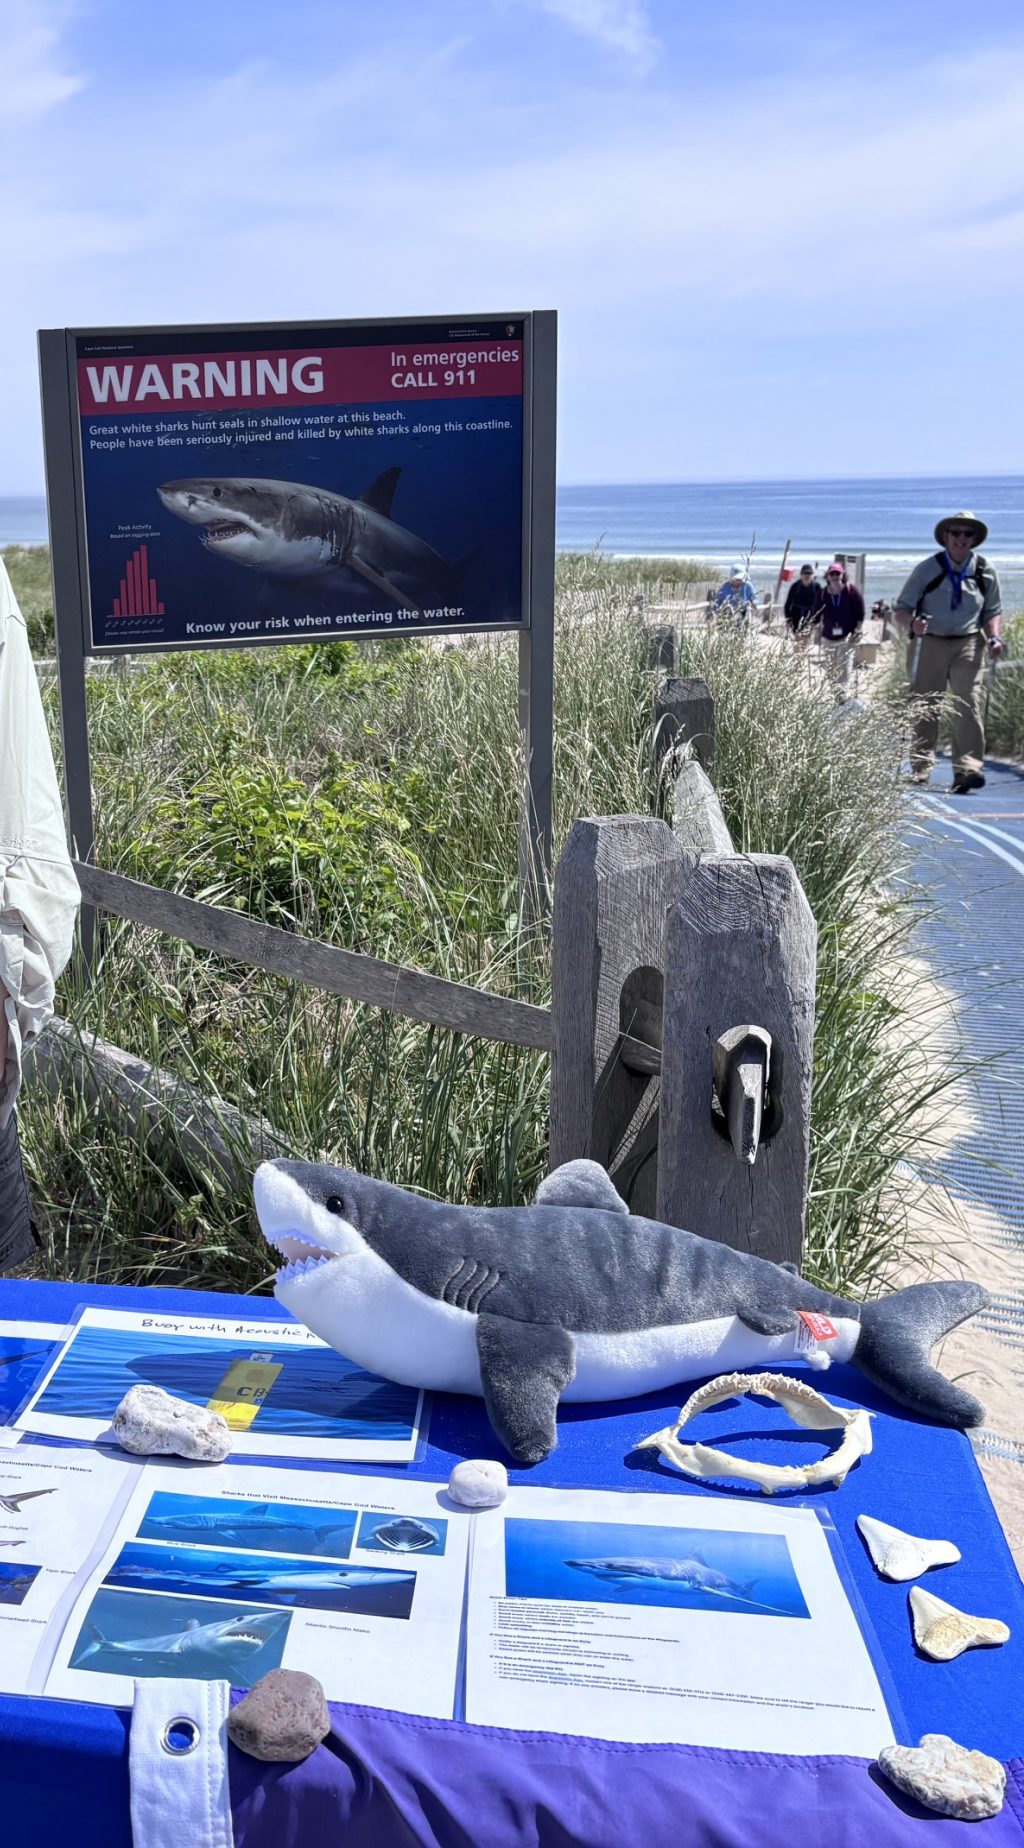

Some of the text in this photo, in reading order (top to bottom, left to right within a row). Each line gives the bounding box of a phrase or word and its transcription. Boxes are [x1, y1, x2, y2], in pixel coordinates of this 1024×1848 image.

[391, 347, 520, 368] In emergencies
[86, 356, 324, 403] WARNING
[391, 370, 476, 388] CALL 911
[89, 410, 406, 435] Great white sharks hunt seals in shallow water at this beach.
[90, 419, 512, 451] People have been seriously injured and killed by white sharks along this coastline.
[186, 606, 465, 634] Know your risk when entering the water.
[142, 1319, 184, 1330] Buoy
[189, 1324, 226, 1333] with
[235, 1326, 302, 1336] Acoustic
